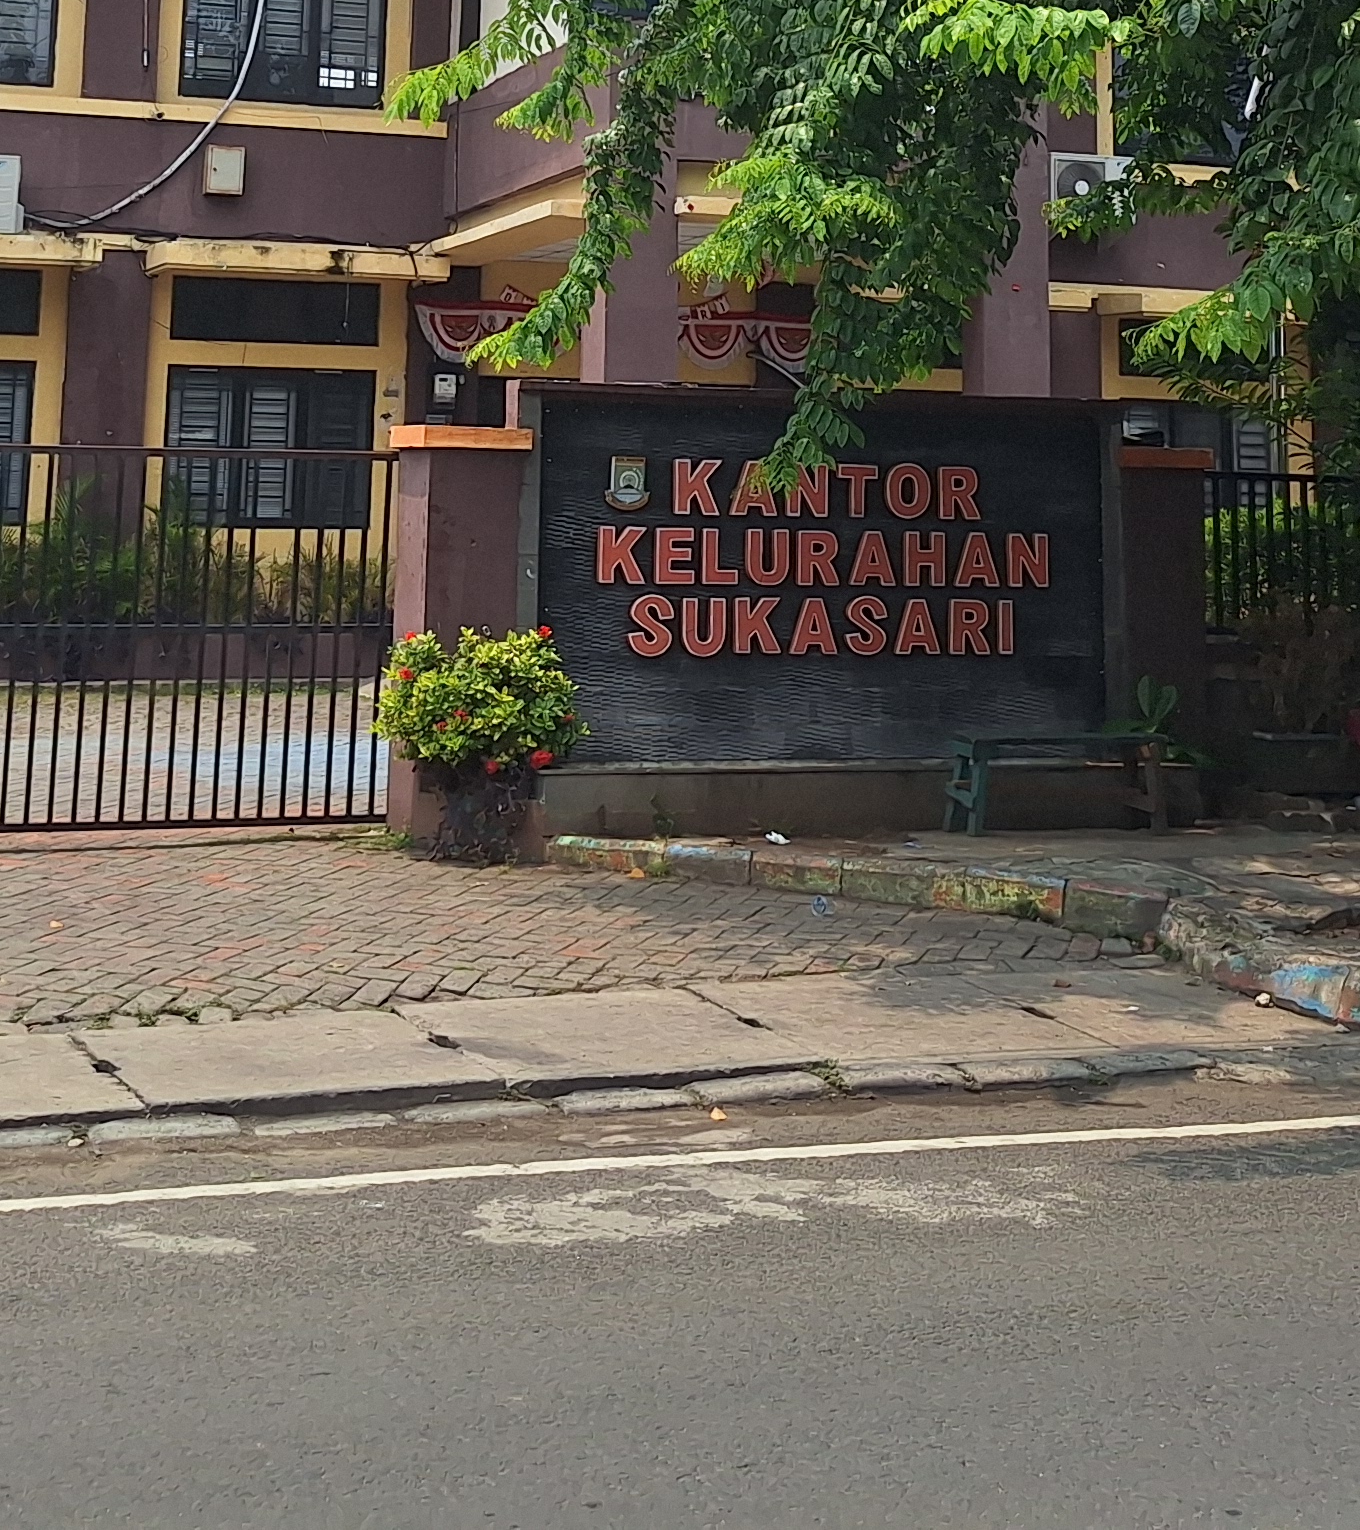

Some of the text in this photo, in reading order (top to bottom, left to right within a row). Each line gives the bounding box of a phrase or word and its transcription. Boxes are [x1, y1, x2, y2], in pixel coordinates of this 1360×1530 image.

[672, 457, 982, 521] KANTOR
[595, 524, 1051, 590] KELURAHAN
[627, 592, 1015, 658] SUKASARI
